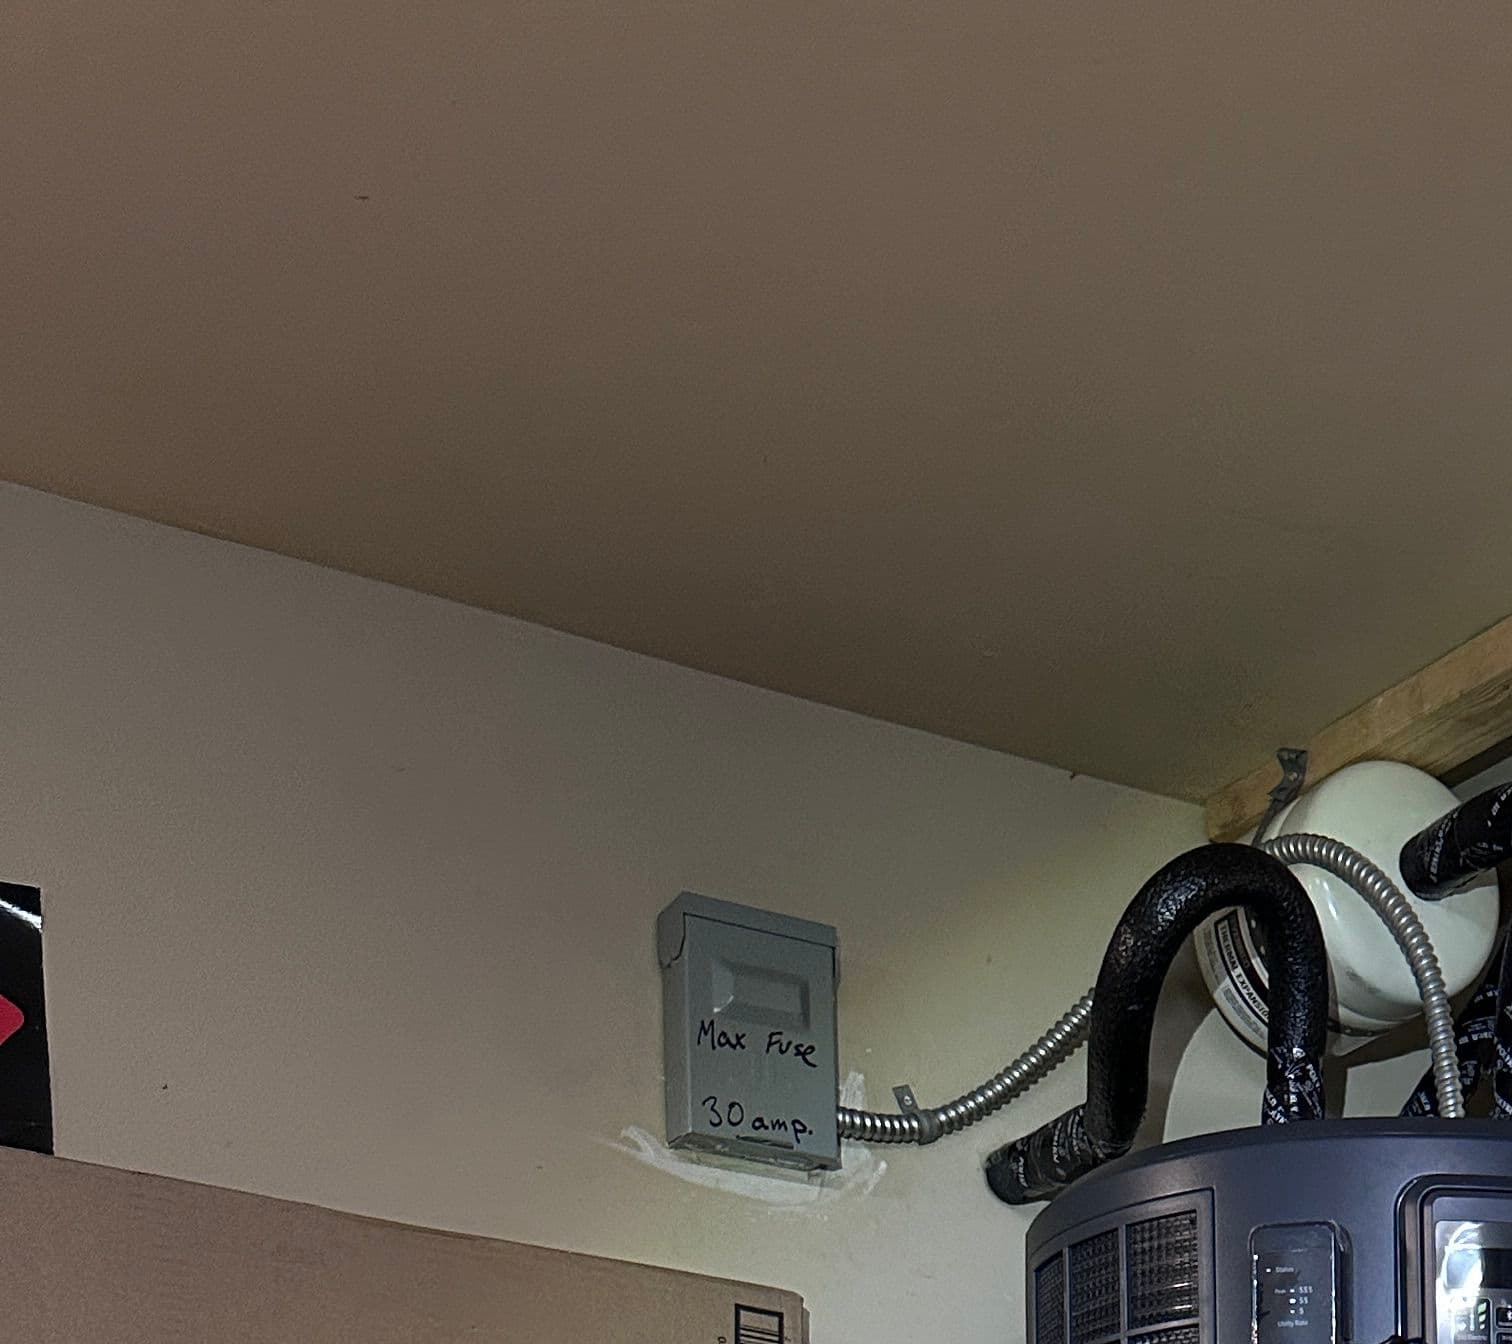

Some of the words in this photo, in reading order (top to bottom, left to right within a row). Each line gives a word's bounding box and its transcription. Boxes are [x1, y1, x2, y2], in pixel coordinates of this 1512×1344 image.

[697, 1019, 746, 1051] Max
[765, 1031, 818, 1068] Fuse
[701, 1095, 745, 1127] 30
